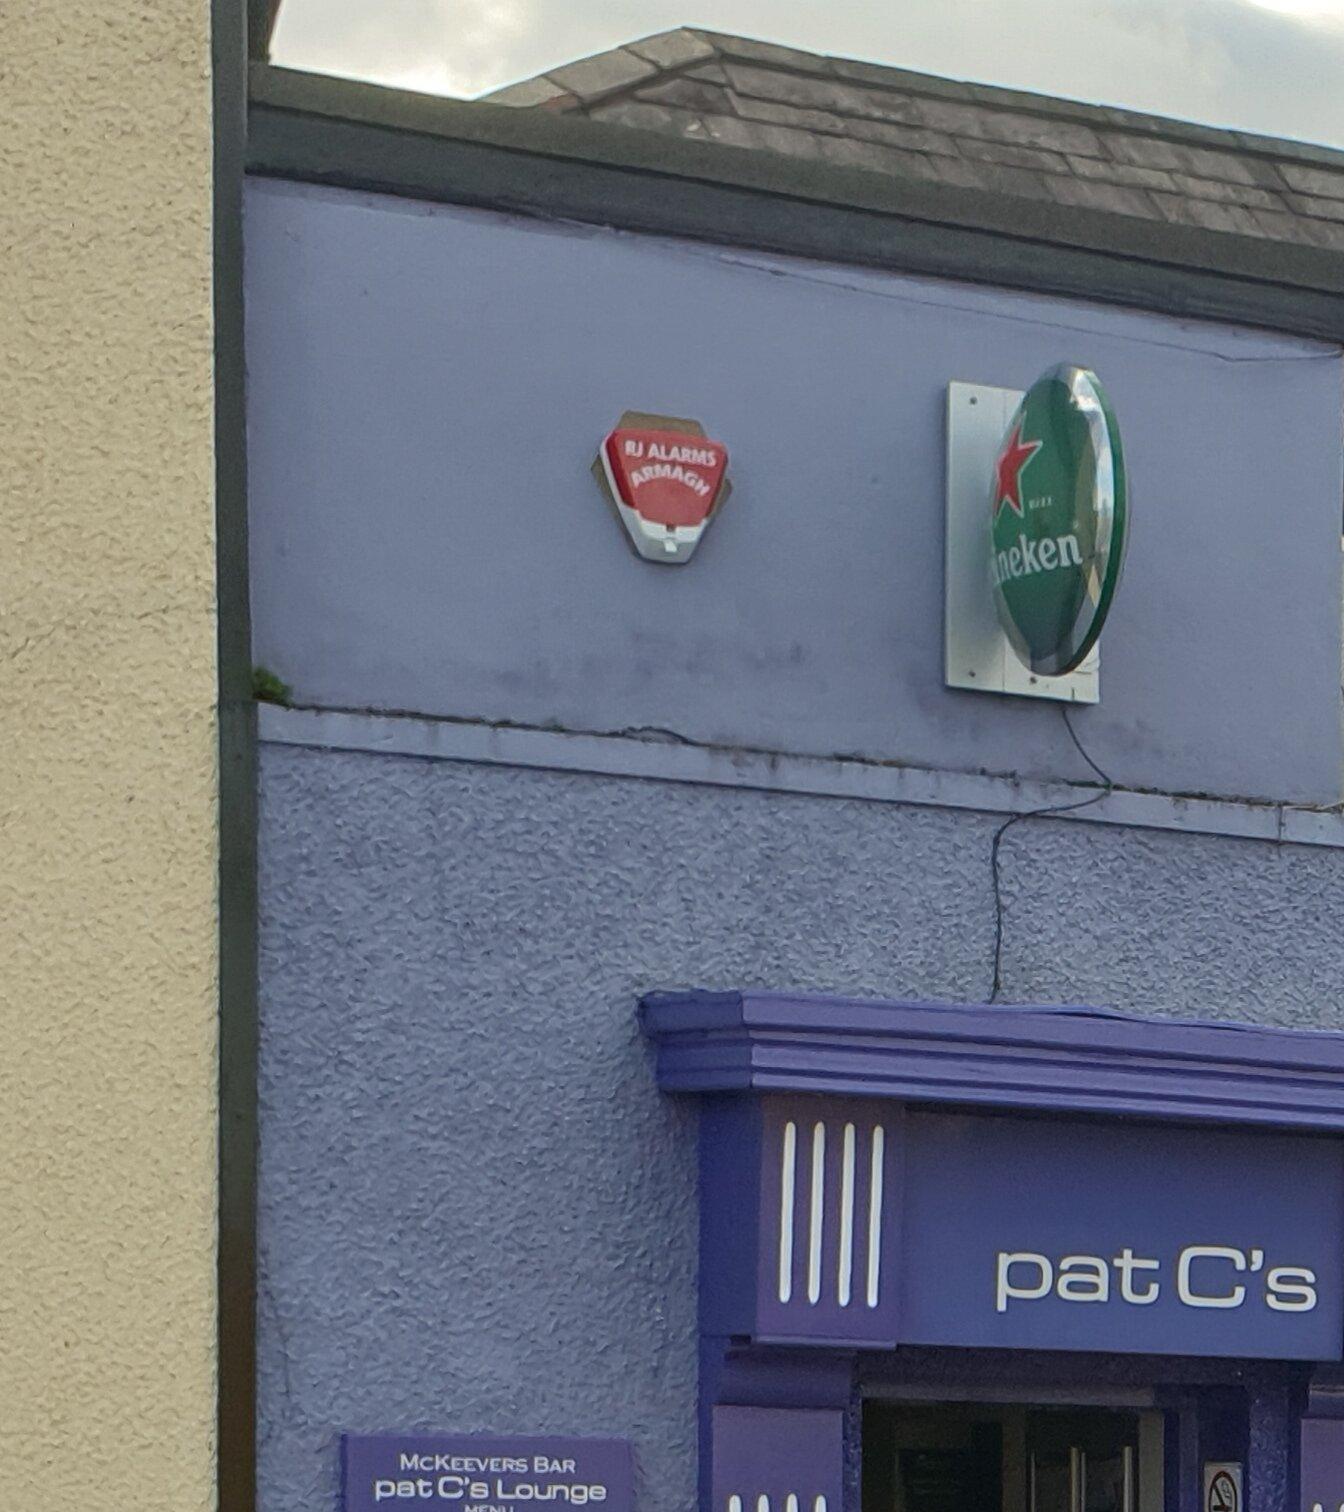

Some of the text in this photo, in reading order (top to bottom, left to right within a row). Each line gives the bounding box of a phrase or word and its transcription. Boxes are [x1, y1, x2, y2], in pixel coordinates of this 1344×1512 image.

[647, 443, 716, 467] ALARMS
[631, 464, 711, 496] ARMAGH
[996, 1246, 1317, 1312] pat C's
[374, 1475, 607, 1505] pat C's Lounge
